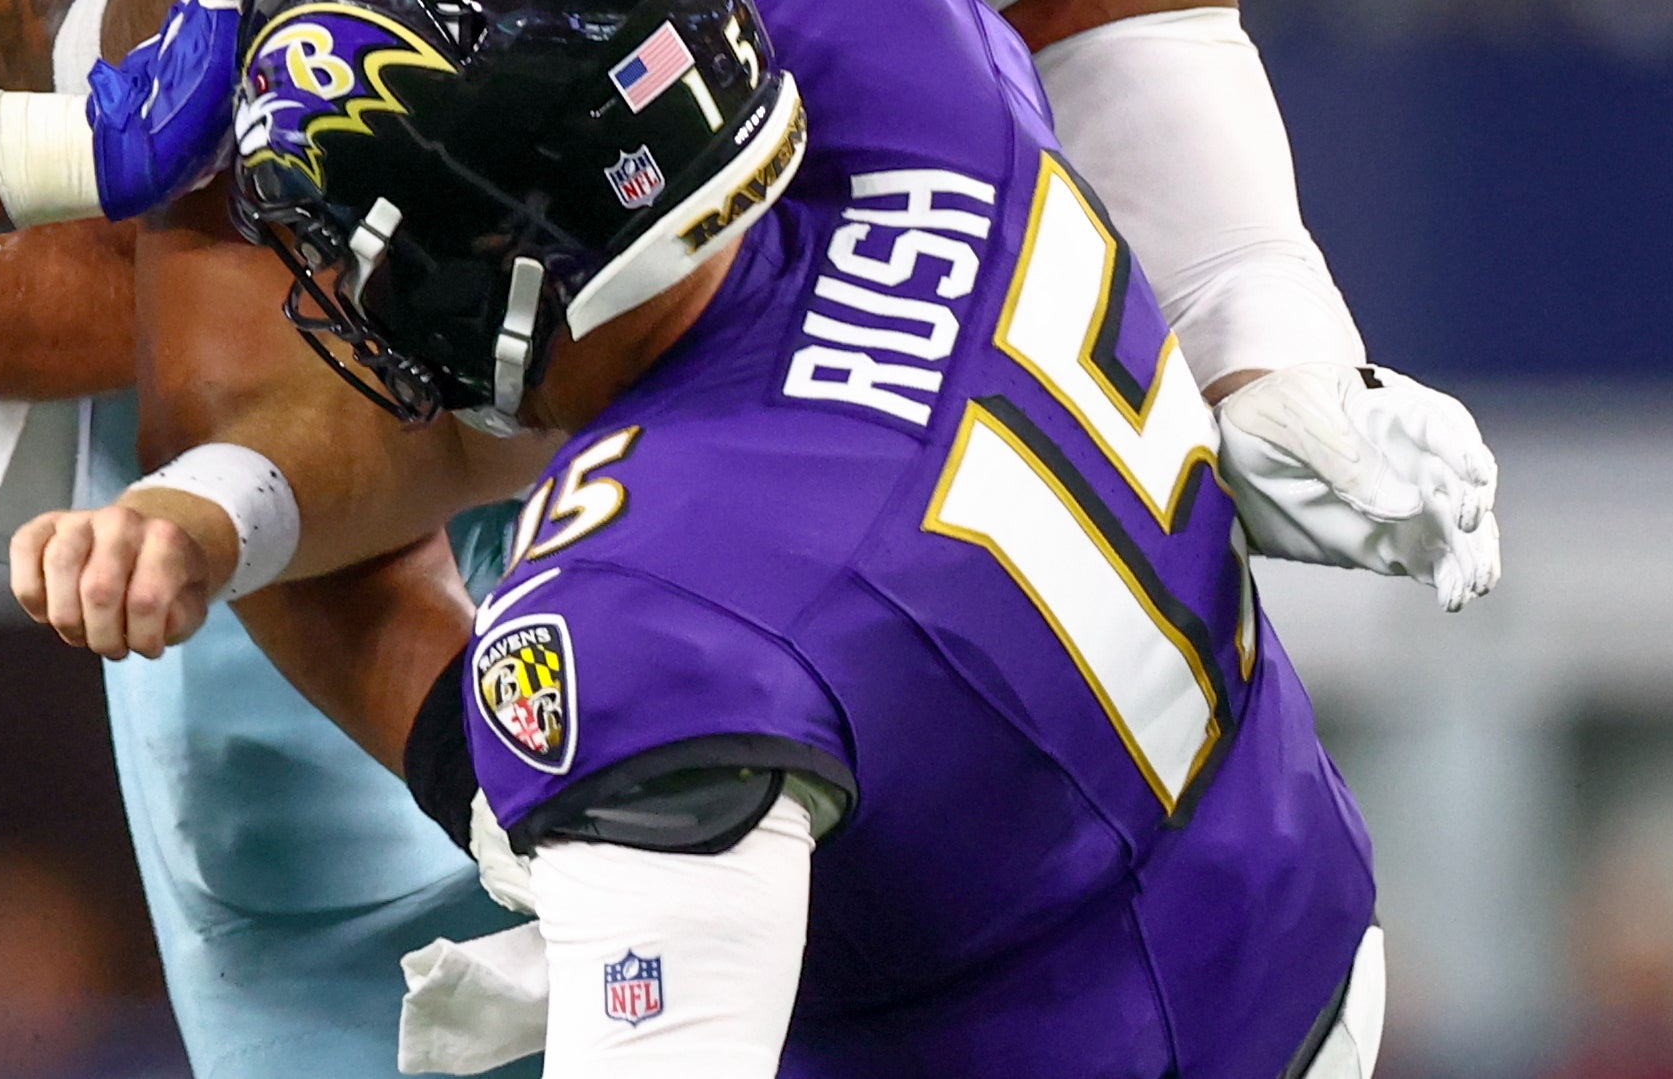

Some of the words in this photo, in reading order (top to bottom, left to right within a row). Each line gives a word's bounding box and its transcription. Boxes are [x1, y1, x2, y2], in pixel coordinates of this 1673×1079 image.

[257, 22, 355, 101] B
[621, 170, 660, 201] NFL
[781, 168, 996, 428] RUSH
[496, 424, 646, 587] 15
[921, 149, 1258, 828] 15
[479, 627, 552, 672] RAVENS
[610, 980, 659, 1018] NFL
